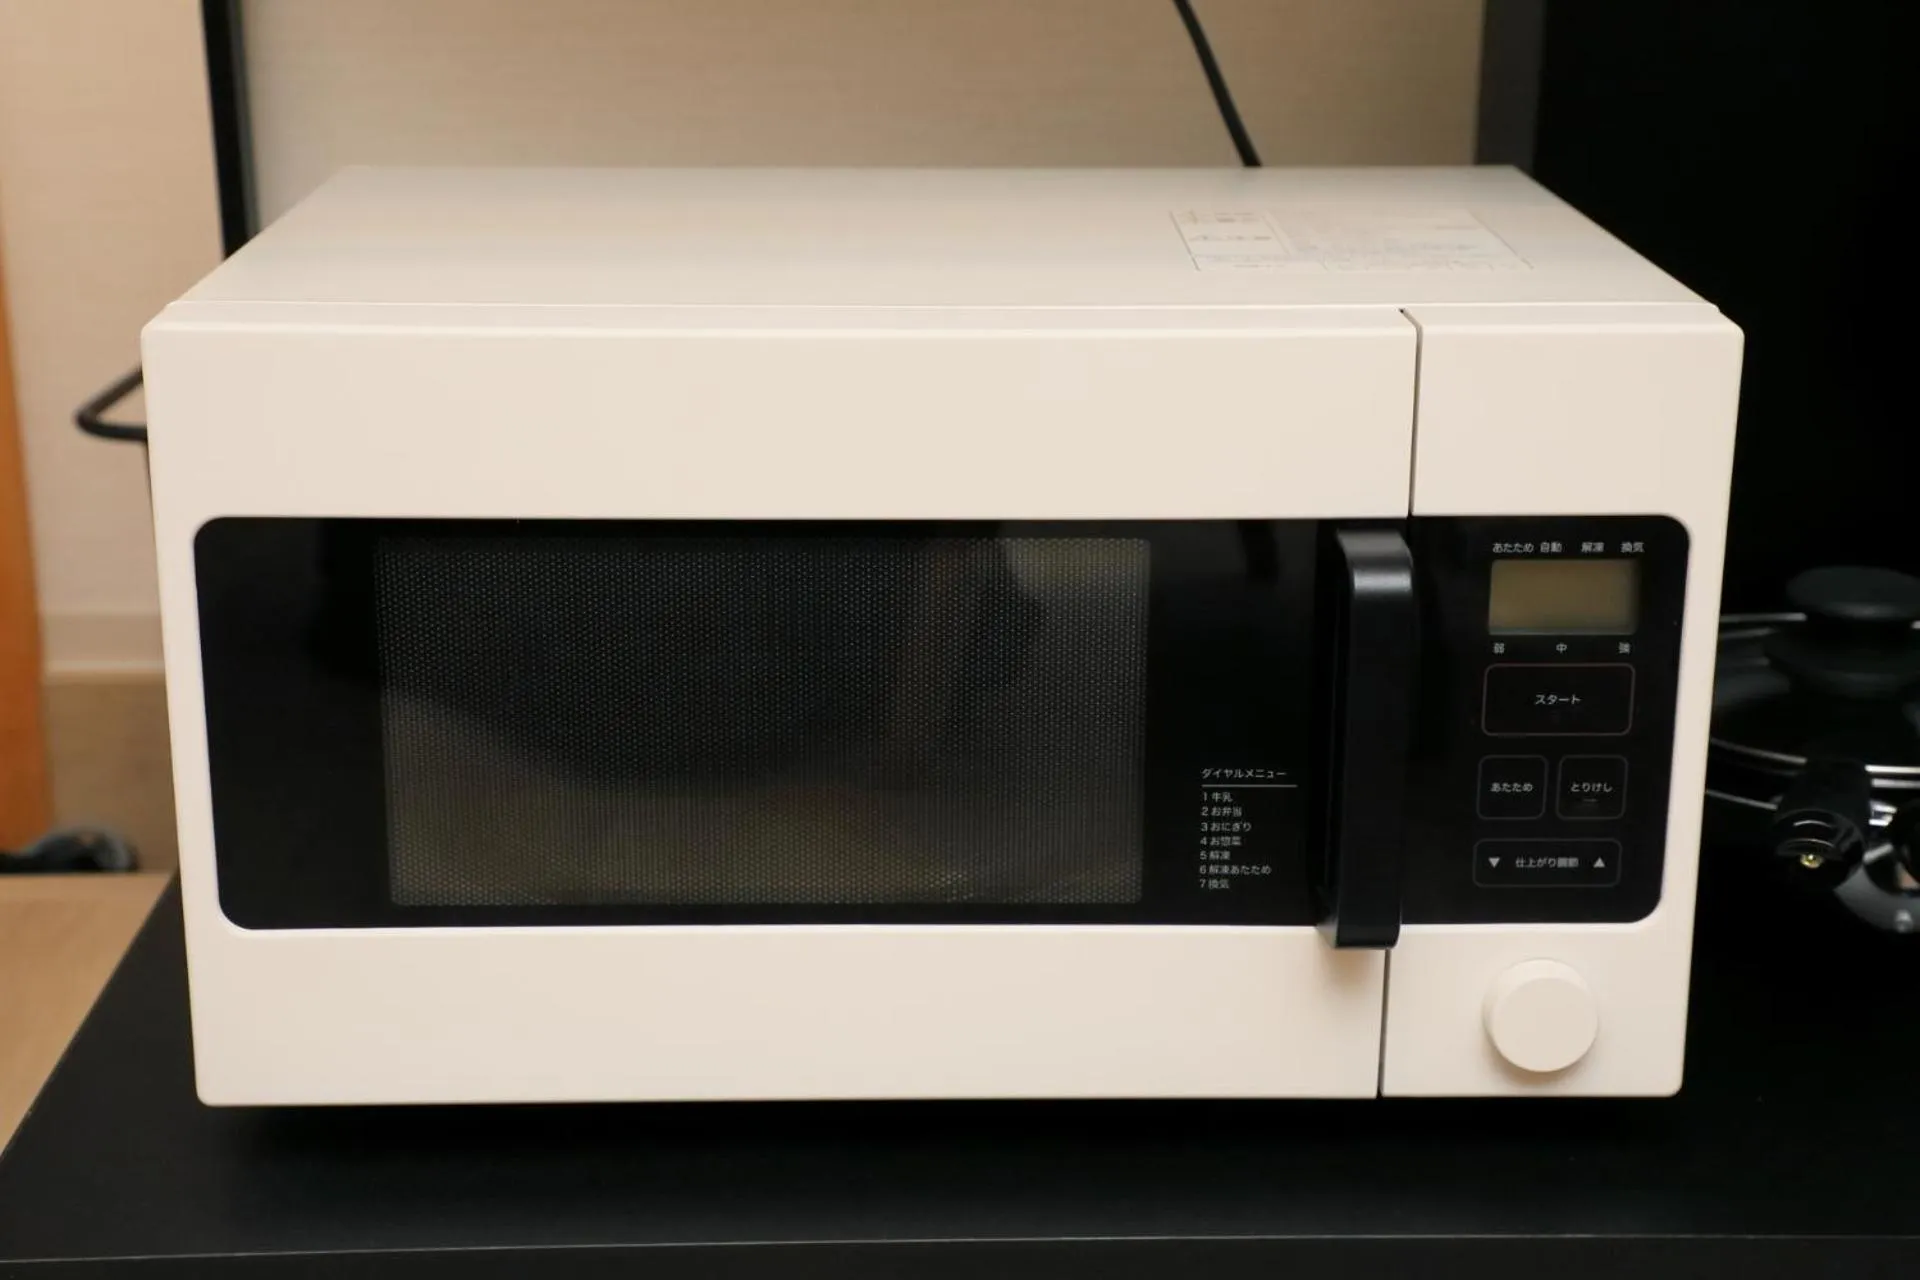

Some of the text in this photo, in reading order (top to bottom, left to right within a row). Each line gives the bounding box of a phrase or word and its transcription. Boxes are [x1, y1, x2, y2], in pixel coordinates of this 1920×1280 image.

[1556, 643, 1567, 653] 中
[1535, 695, 1581, 704] スタート
[1202, 768, 1286, 779] ダイヤルメニュー
[1490, 782, 1533, 792] あたため
[1571, 782, 1612, 792] とりけし
[1201, 806, 1208, 816] 2
[1201, 821, 1251, 832] 3 おにぎり
[1200, 836, 1207, 845] 4
[1200, 850, 1208, 860] 5
[1199, 865, 1206, 874] 6
[1200, 879, 1206, 888] 7
